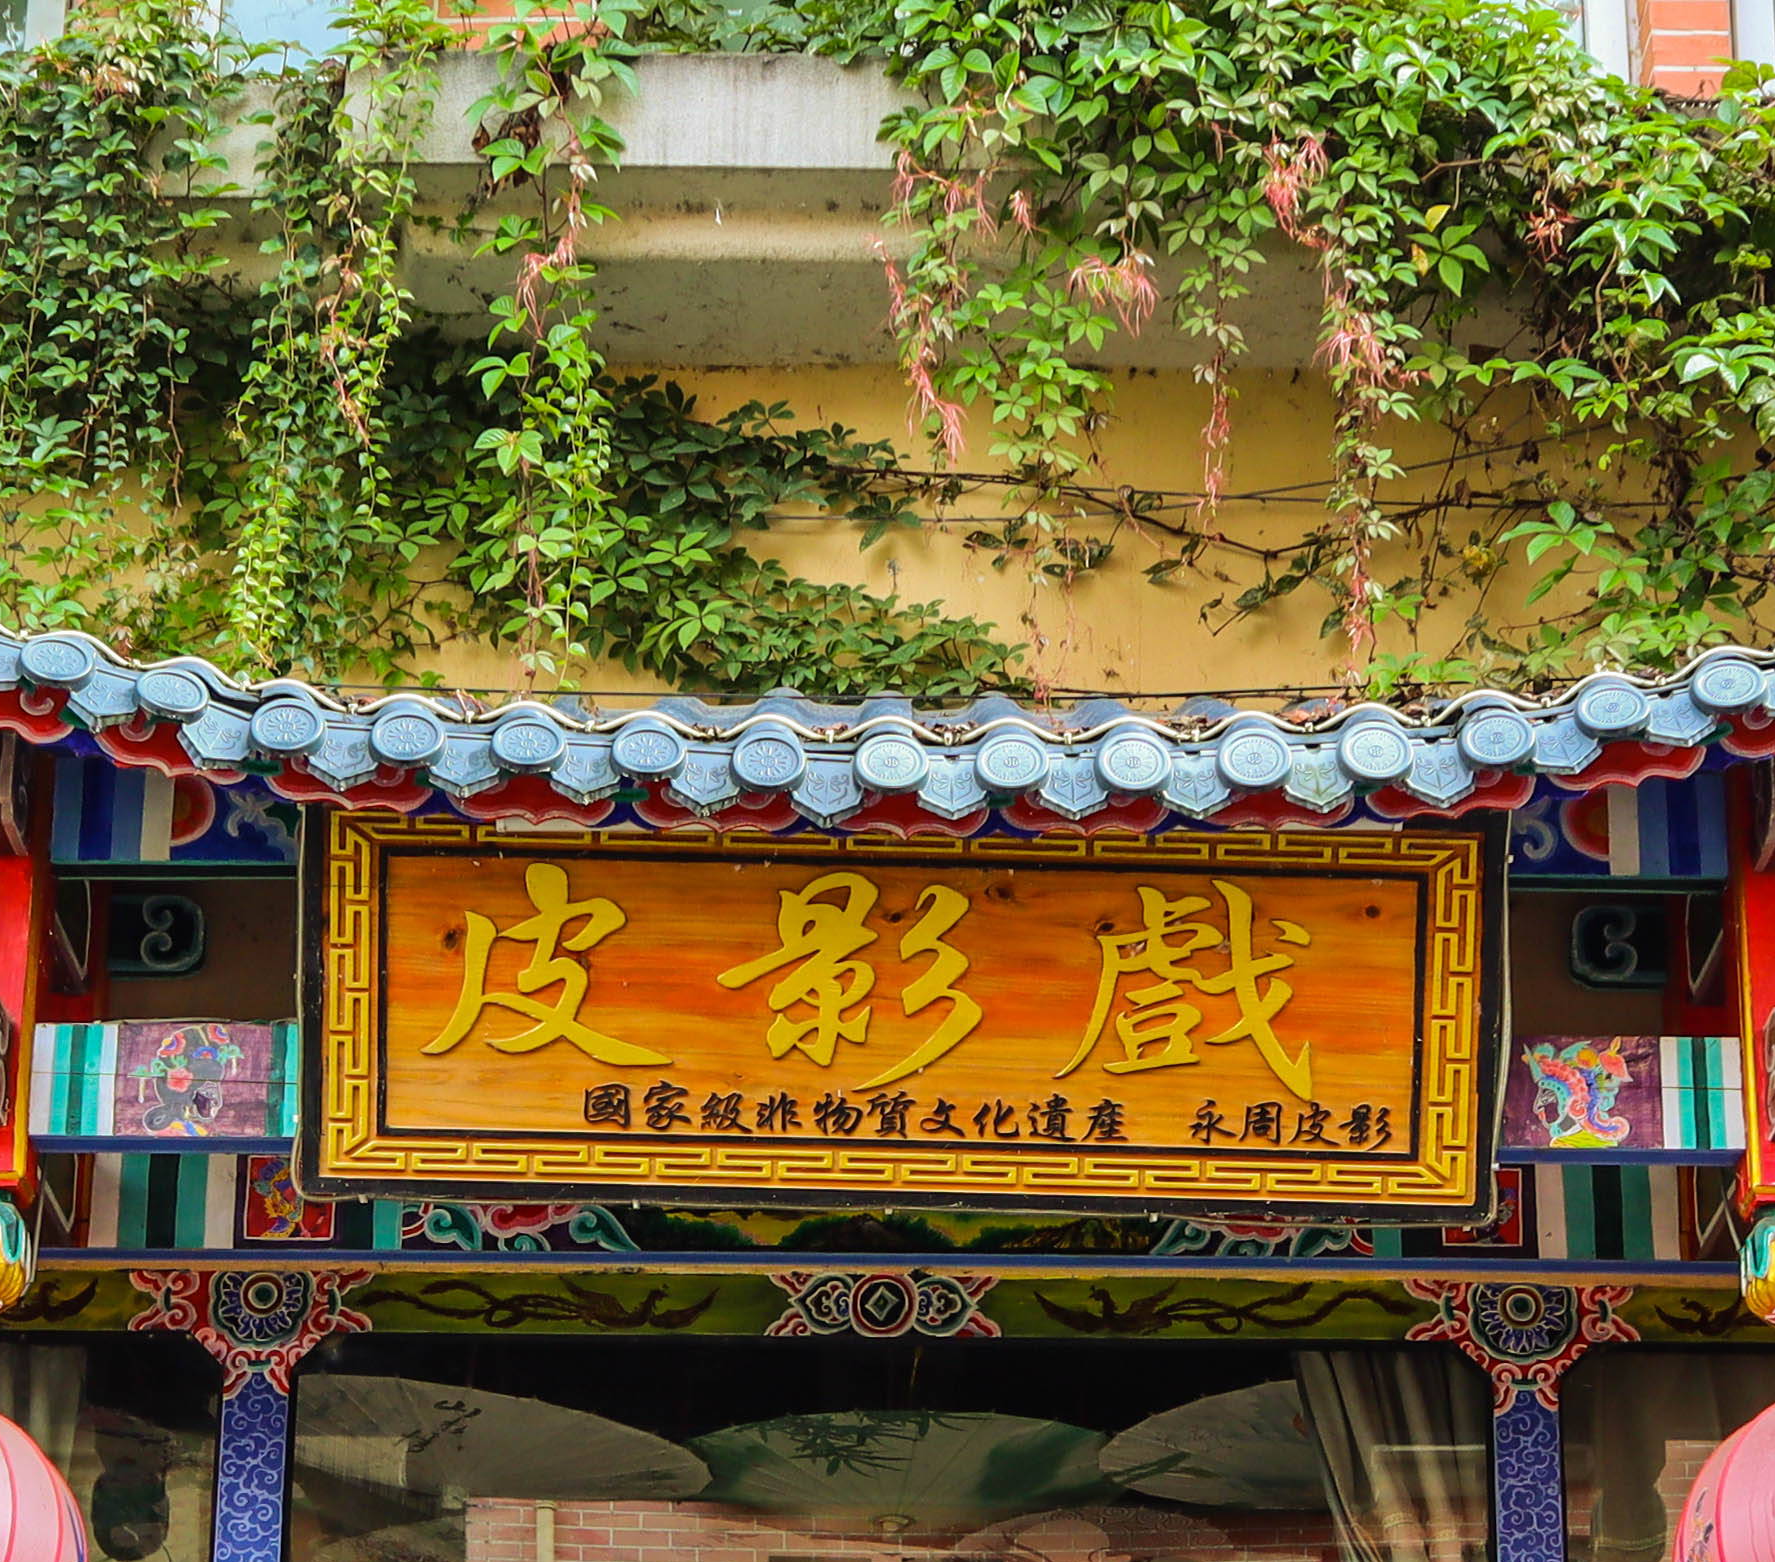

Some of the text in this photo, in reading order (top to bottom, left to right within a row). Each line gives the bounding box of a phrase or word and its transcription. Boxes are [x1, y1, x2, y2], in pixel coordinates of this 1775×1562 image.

[421, 862, 1313, 1101] 皮影戲
[1188, 1099, 1393, 1152] 永周皮影
